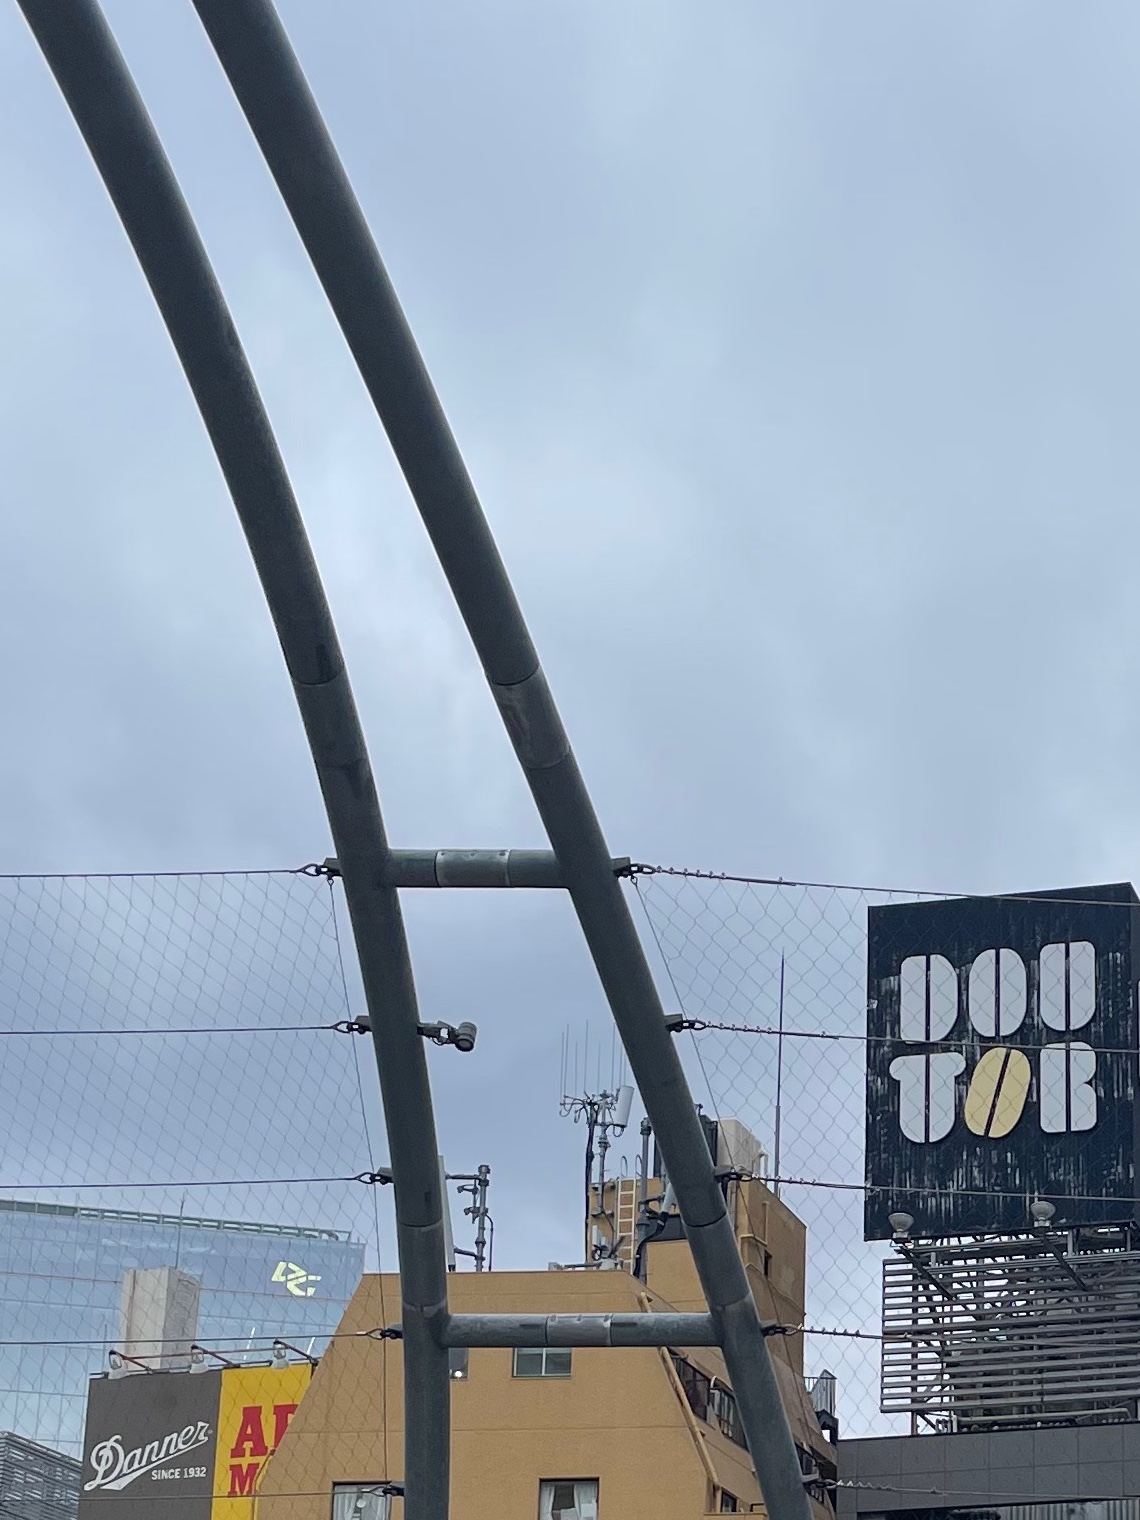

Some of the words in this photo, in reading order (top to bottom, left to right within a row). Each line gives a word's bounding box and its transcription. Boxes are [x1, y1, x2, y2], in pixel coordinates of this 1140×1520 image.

[901, 941, 1096, 1043] DOU
[889, 1042, 1097, 1143] TOR
[84, 1421, 210, 1492] Danner
[151, 1468, 181, 1481] SINCE
[183, 1466, 207, 1479] 1932
